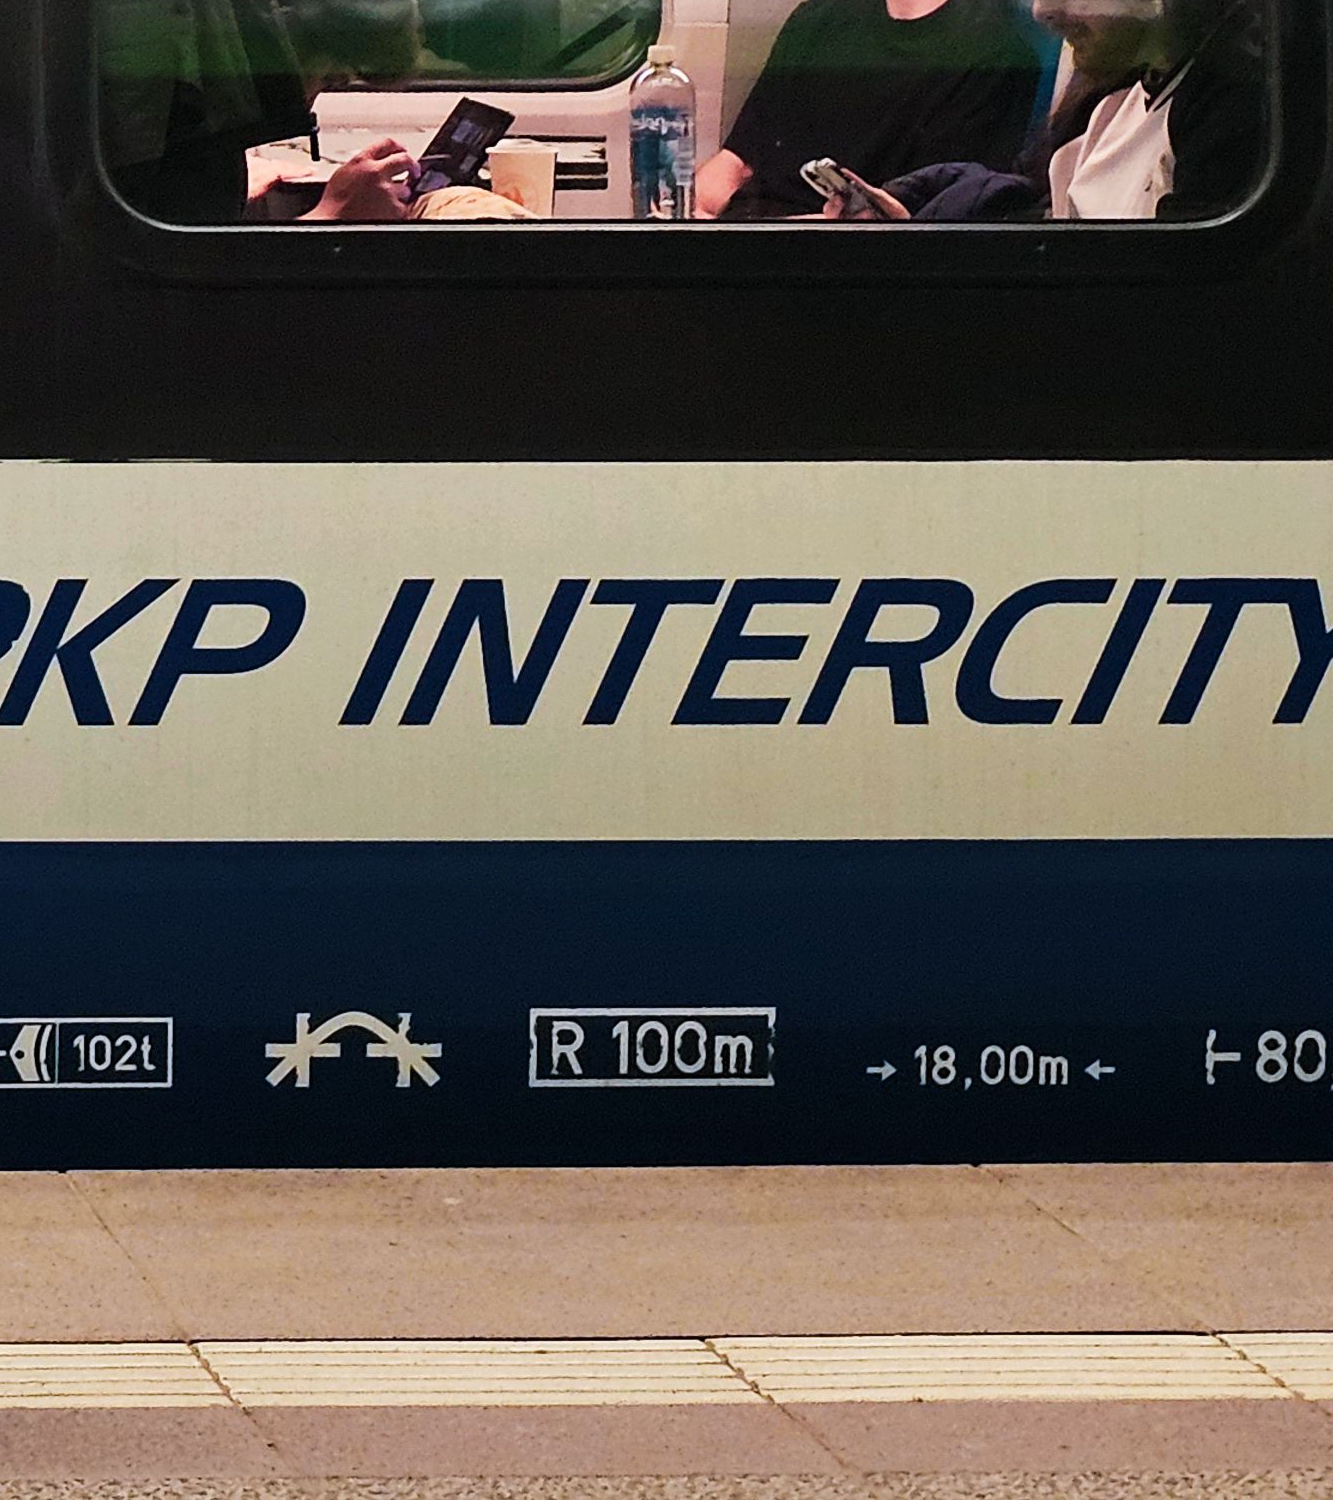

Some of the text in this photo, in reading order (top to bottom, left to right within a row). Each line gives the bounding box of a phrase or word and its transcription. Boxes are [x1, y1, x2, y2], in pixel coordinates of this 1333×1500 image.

[336, 576, 1333, 727] INTERCITY
[72, 1034, 157, 1072] 102t
[550, 1019, 754, 1077] R 100m
[913, 1044, 1070, 1090] 18,00m
